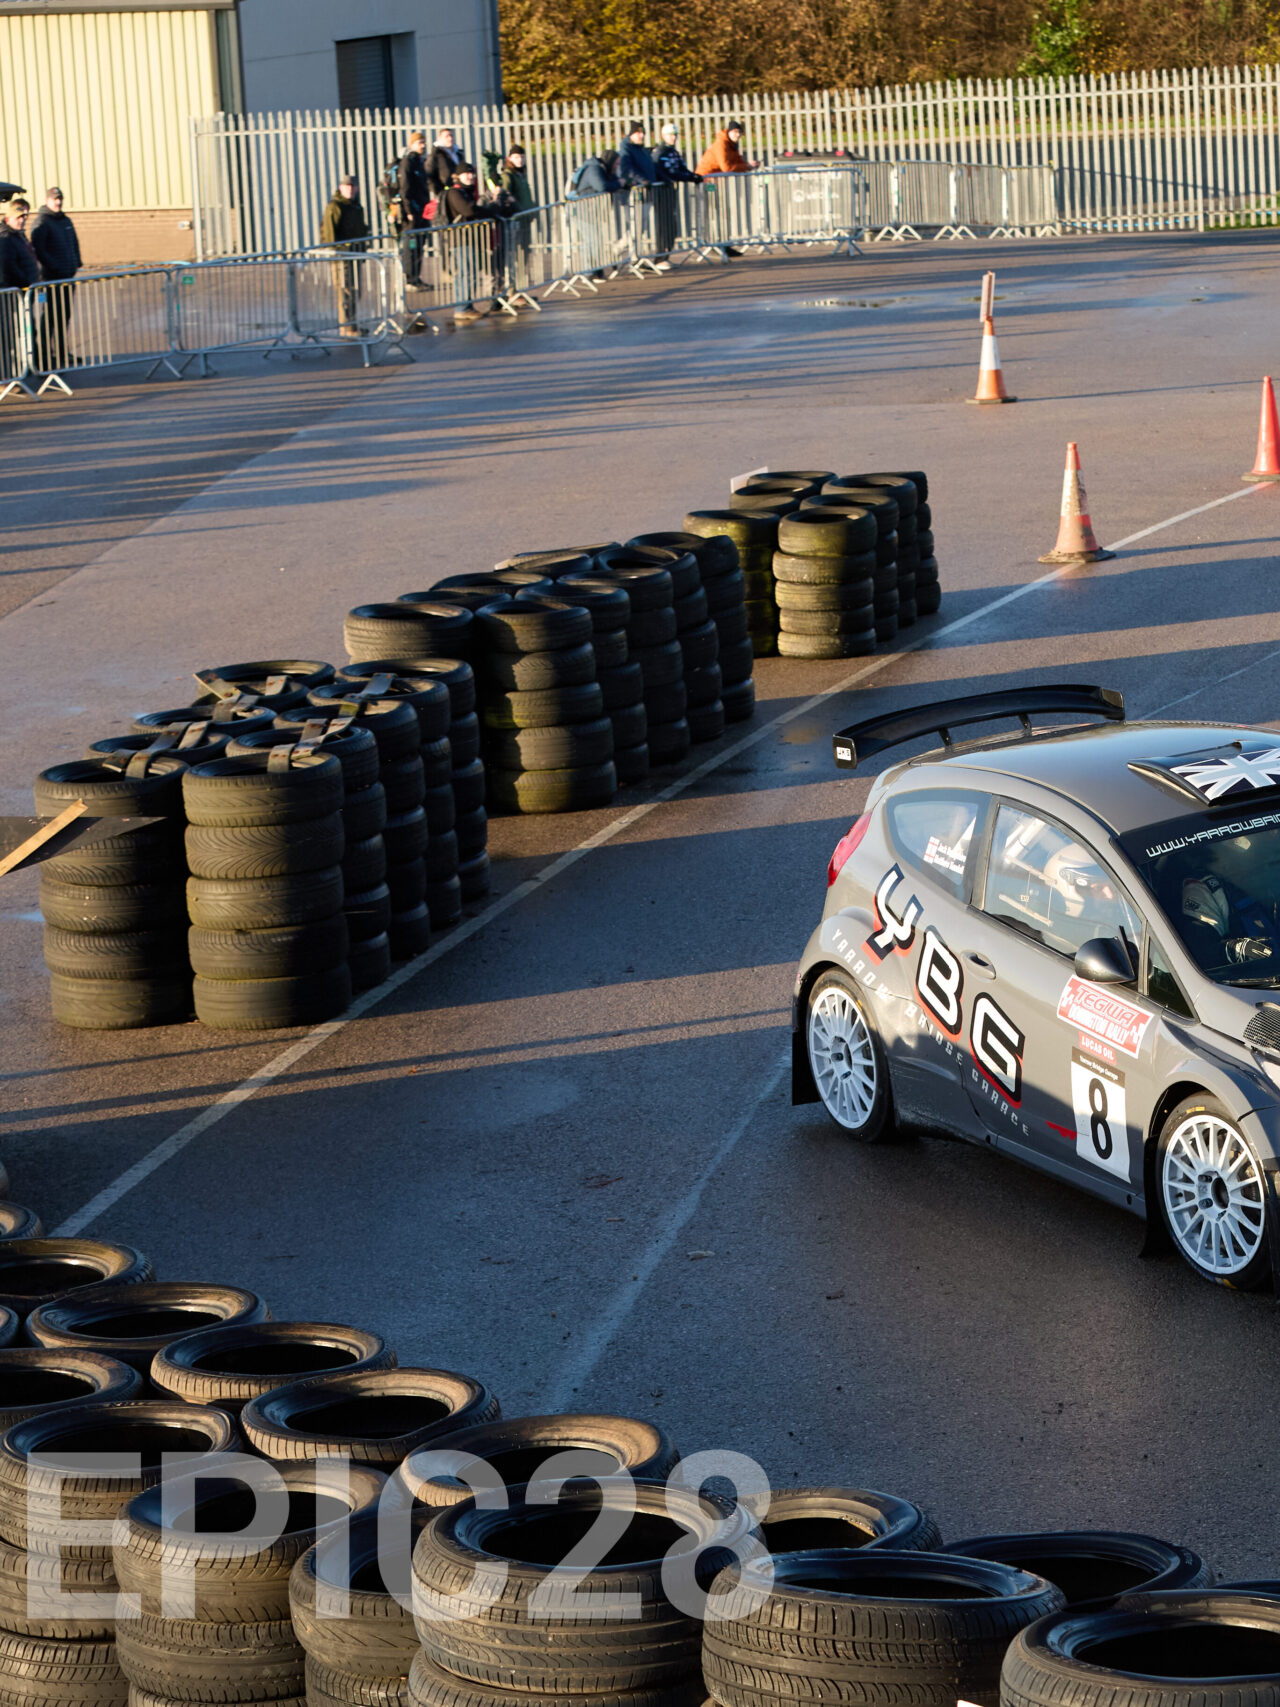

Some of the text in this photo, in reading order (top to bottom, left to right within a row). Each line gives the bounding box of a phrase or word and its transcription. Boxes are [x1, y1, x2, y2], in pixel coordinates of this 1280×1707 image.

[861, 863, 1026, 1108] YBG
[1076, 985, 1139, 1028] TEGIWA
[831, 928, 1030, 1136] YARROW BRIDGE GARAGE
[1081, 1036, 1114, 1061] LUCAS OIL
[1105, 1022, 1129, 1045] RALLY
[1088, 1077, 1113, 1160] 8
